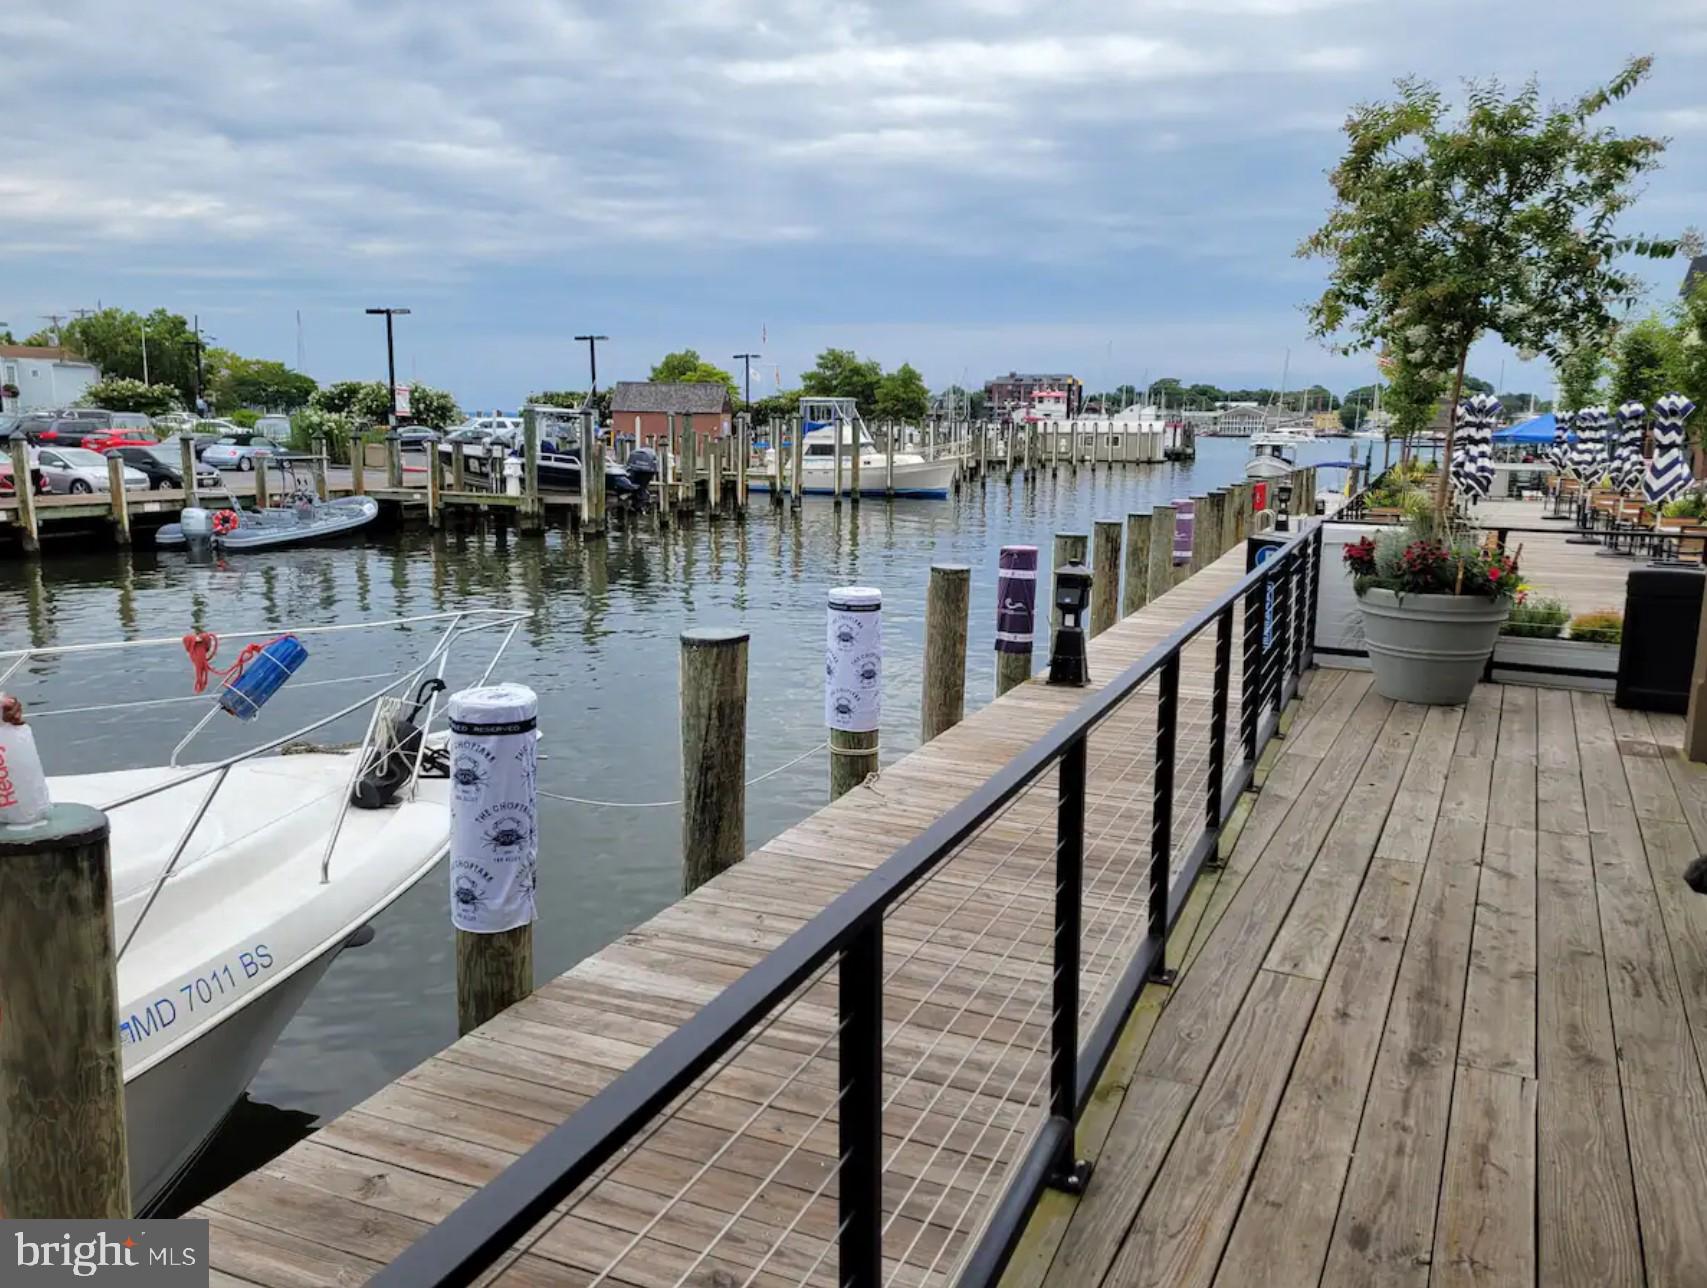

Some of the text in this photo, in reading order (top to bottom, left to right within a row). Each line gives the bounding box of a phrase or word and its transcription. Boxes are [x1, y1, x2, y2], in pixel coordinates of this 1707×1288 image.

[475, 808, 492, 824] THE
[180, 964, 235, 1011] 7011
[239, 944, 274, 979] BS
